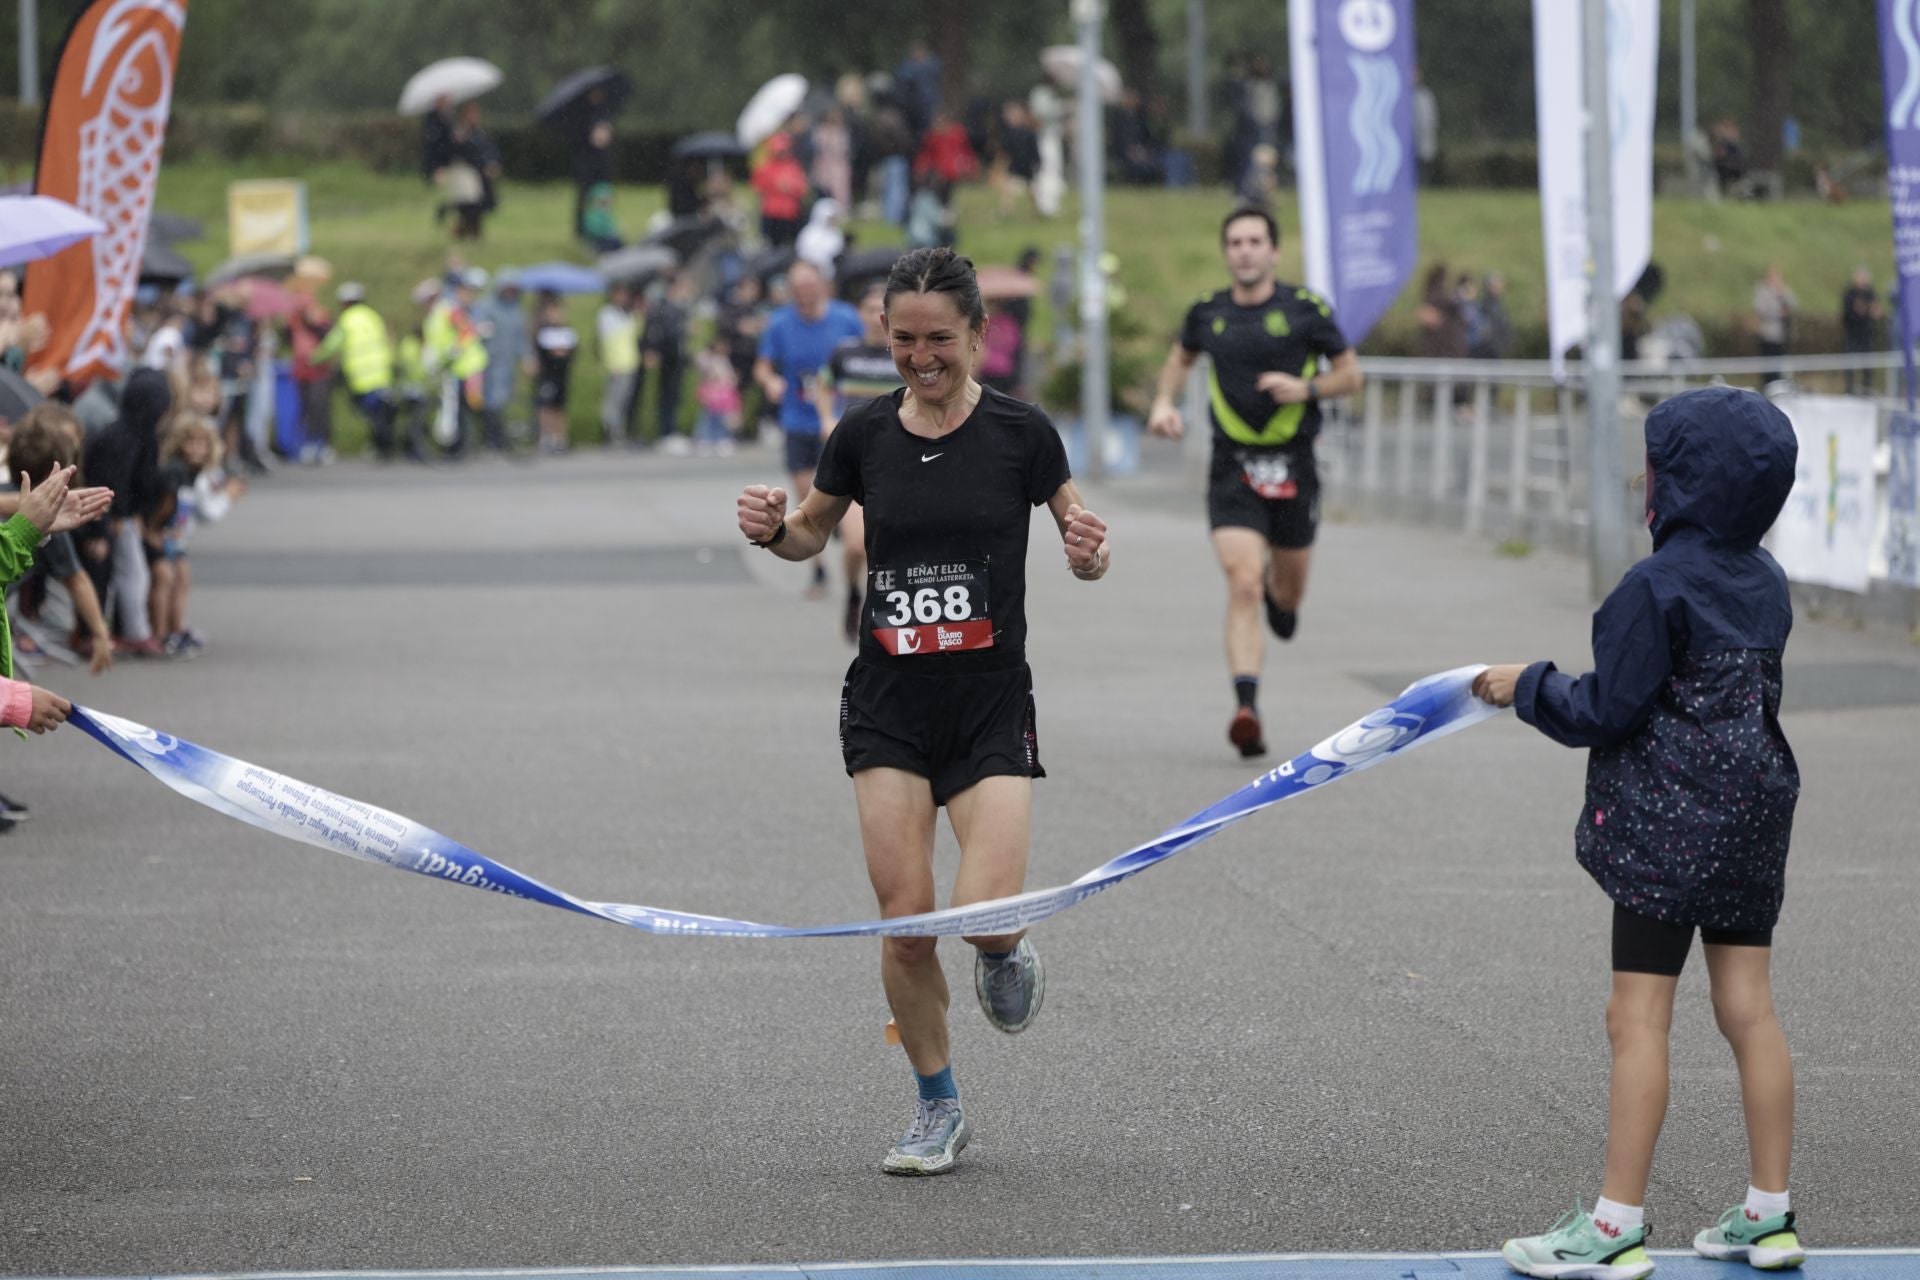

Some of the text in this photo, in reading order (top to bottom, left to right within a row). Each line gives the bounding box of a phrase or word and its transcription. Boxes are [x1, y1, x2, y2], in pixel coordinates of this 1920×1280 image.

[907, 563, 967, 577] BEÑAT ELZO
[914, 575, 935, 584] MENDI
[936, 573, 975, 583] LASTERKETA
[886, 585, 972, 626] 368
[938, 638, 963, 646] VASCO
[282, 783, 311, 807] Bidasoa
[328, 830, 360, 851] Txingudi
[364, 827, 399, 853] Consorcio
